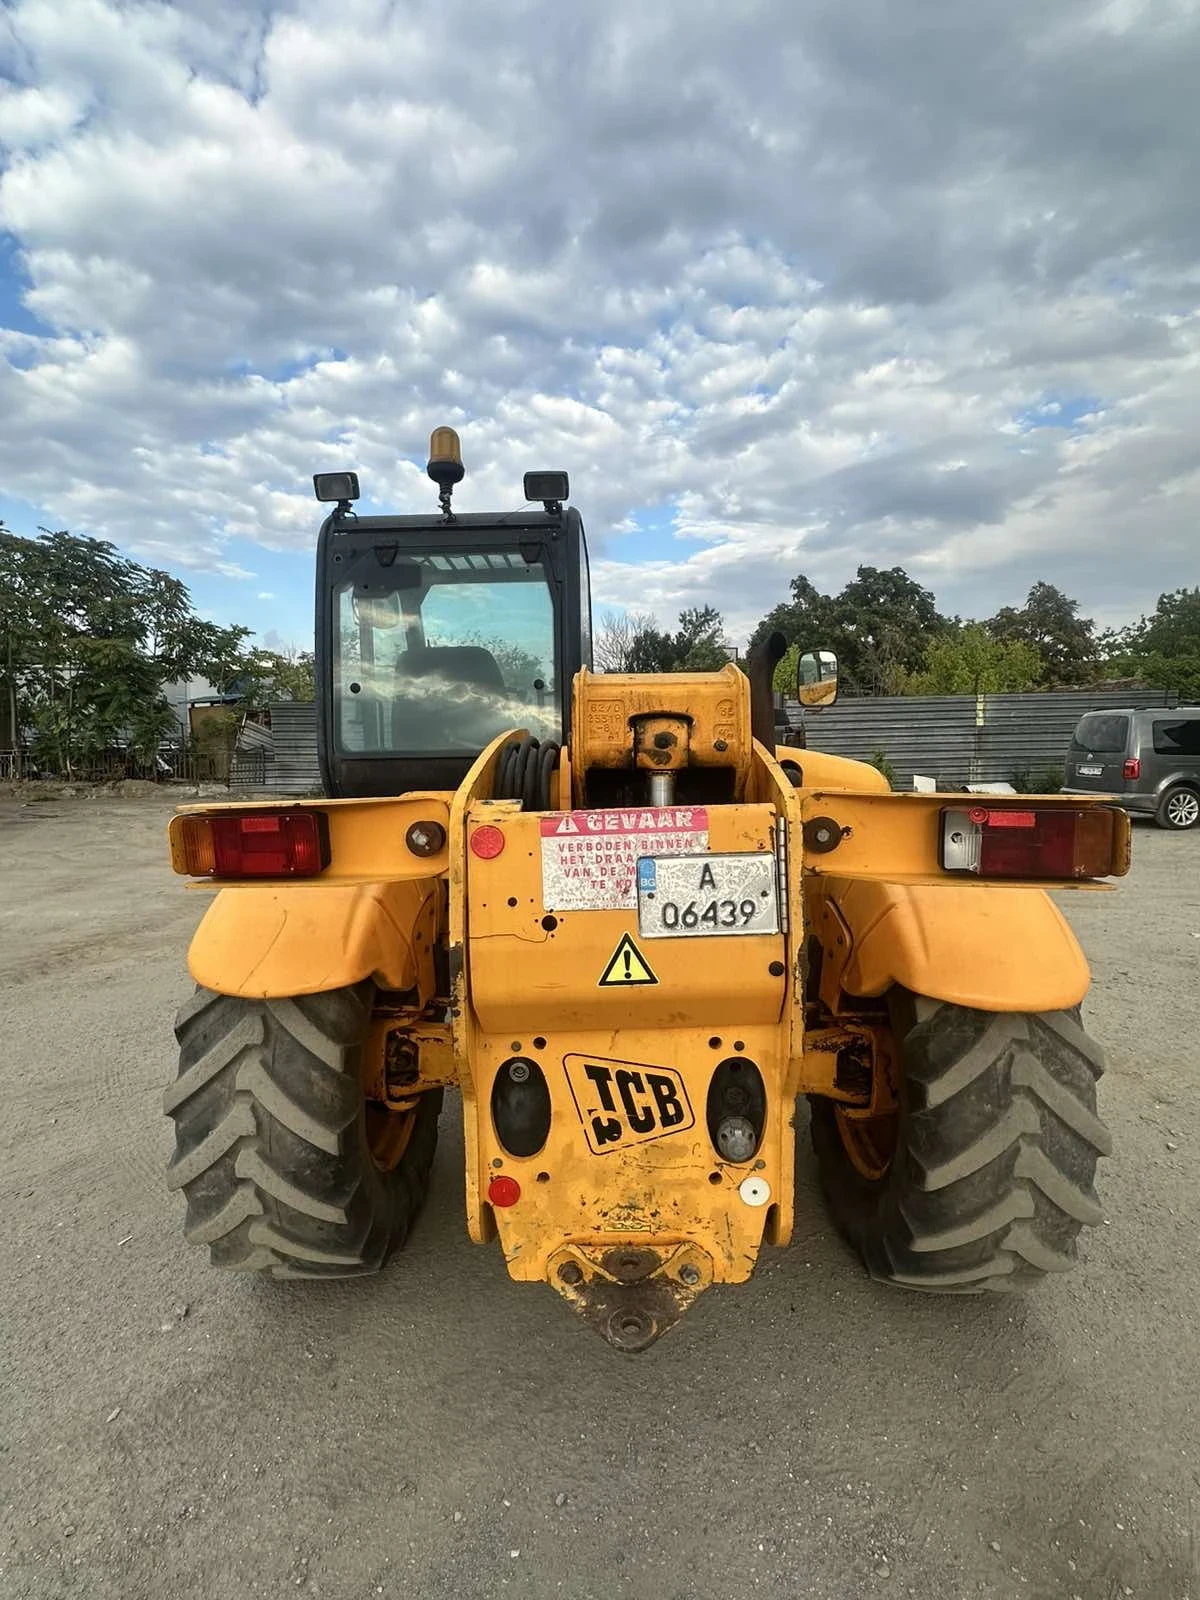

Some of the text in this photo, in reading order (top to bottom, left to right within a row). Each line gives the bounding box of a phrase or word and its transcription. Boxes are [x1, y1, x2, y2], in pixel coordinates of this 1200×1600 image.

[586, 811, 693, 831] GEVAAR
[558, 839, 694, 852] VERBODEN BINNEN
[560, 855, 586, 865] HET
[564, 868, 591, 878] VAN
[600, 867, 617, 876] DE
[699, 863, 716, 890] A
[590, 880, 606, 889] TE
[640, 878, 656, 888] BG
[662, 899, 756, 928] 06439
[583, 1065, 685, 1147] JCB
